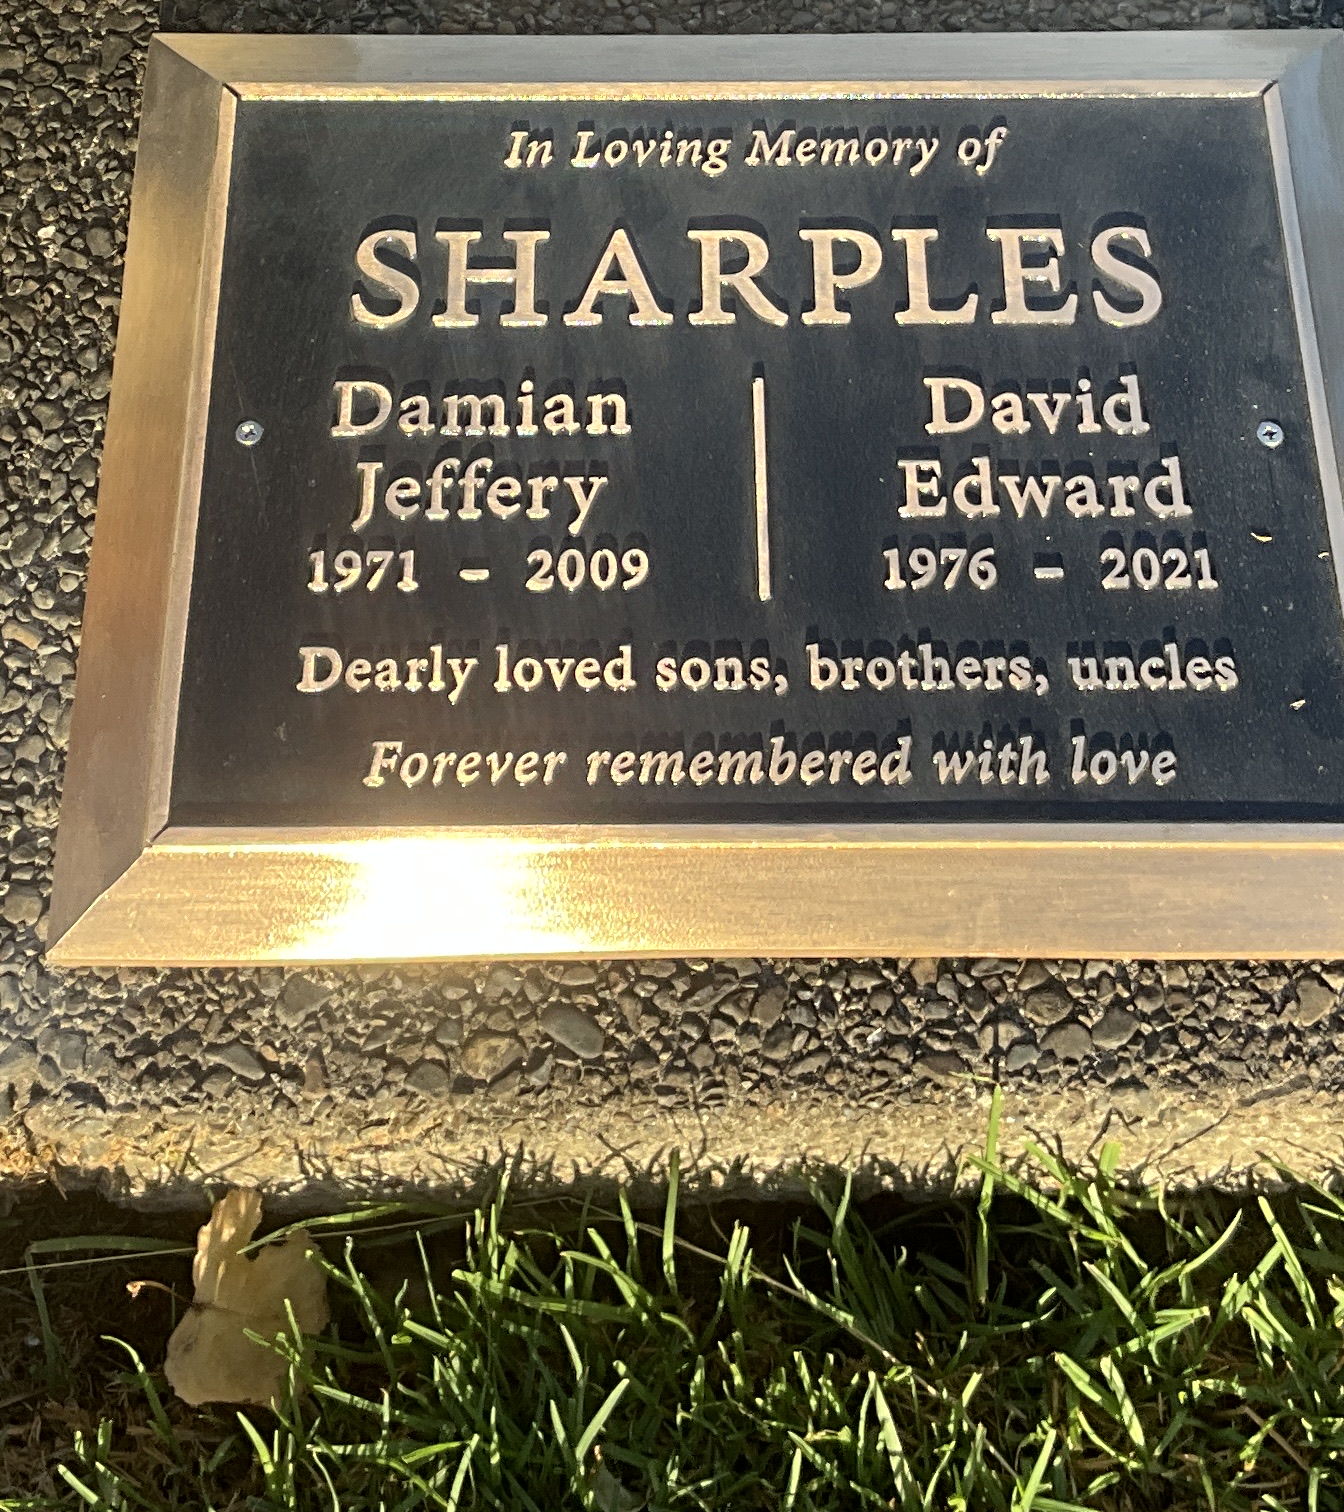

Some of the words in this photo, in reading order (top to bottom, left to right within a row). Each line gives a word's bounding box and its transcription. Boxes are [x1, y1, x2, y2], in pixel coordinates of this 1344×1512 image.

[504, 129, 554, 168] In
[572, 129, 731, 176] Loving
[747, 129, 942, 175] Memory
[957, 125, 1009, 174] of
[349, 226, 1164, 328] SHARPLES
[331, 379, 632, 437] Damian
[924, 377, 1149, 436] David
[352, 459, 609, 535] Jeffery
[898, 459, 1192, 519] Edward
[306, 549, 418, 593] 1971
[525, 548, 650, 593] 2009
[883, 548, 997, 591] 1976
[1101, 547, 1218, 592] 2021
[296, 647, 478, 704] Dearly
[493, 645, 635, 693] loved
[654, 651, 788, 697] sons,
[808, 645, 1051, 697] brothers,
[1068, 645, 1239, 691] uncles
[364, 741, 566, 790] Forever
[587, 737, 915, 788] remembered
[933, 737, 1050, 787] with
[1070, 737, 1177, 787] love
